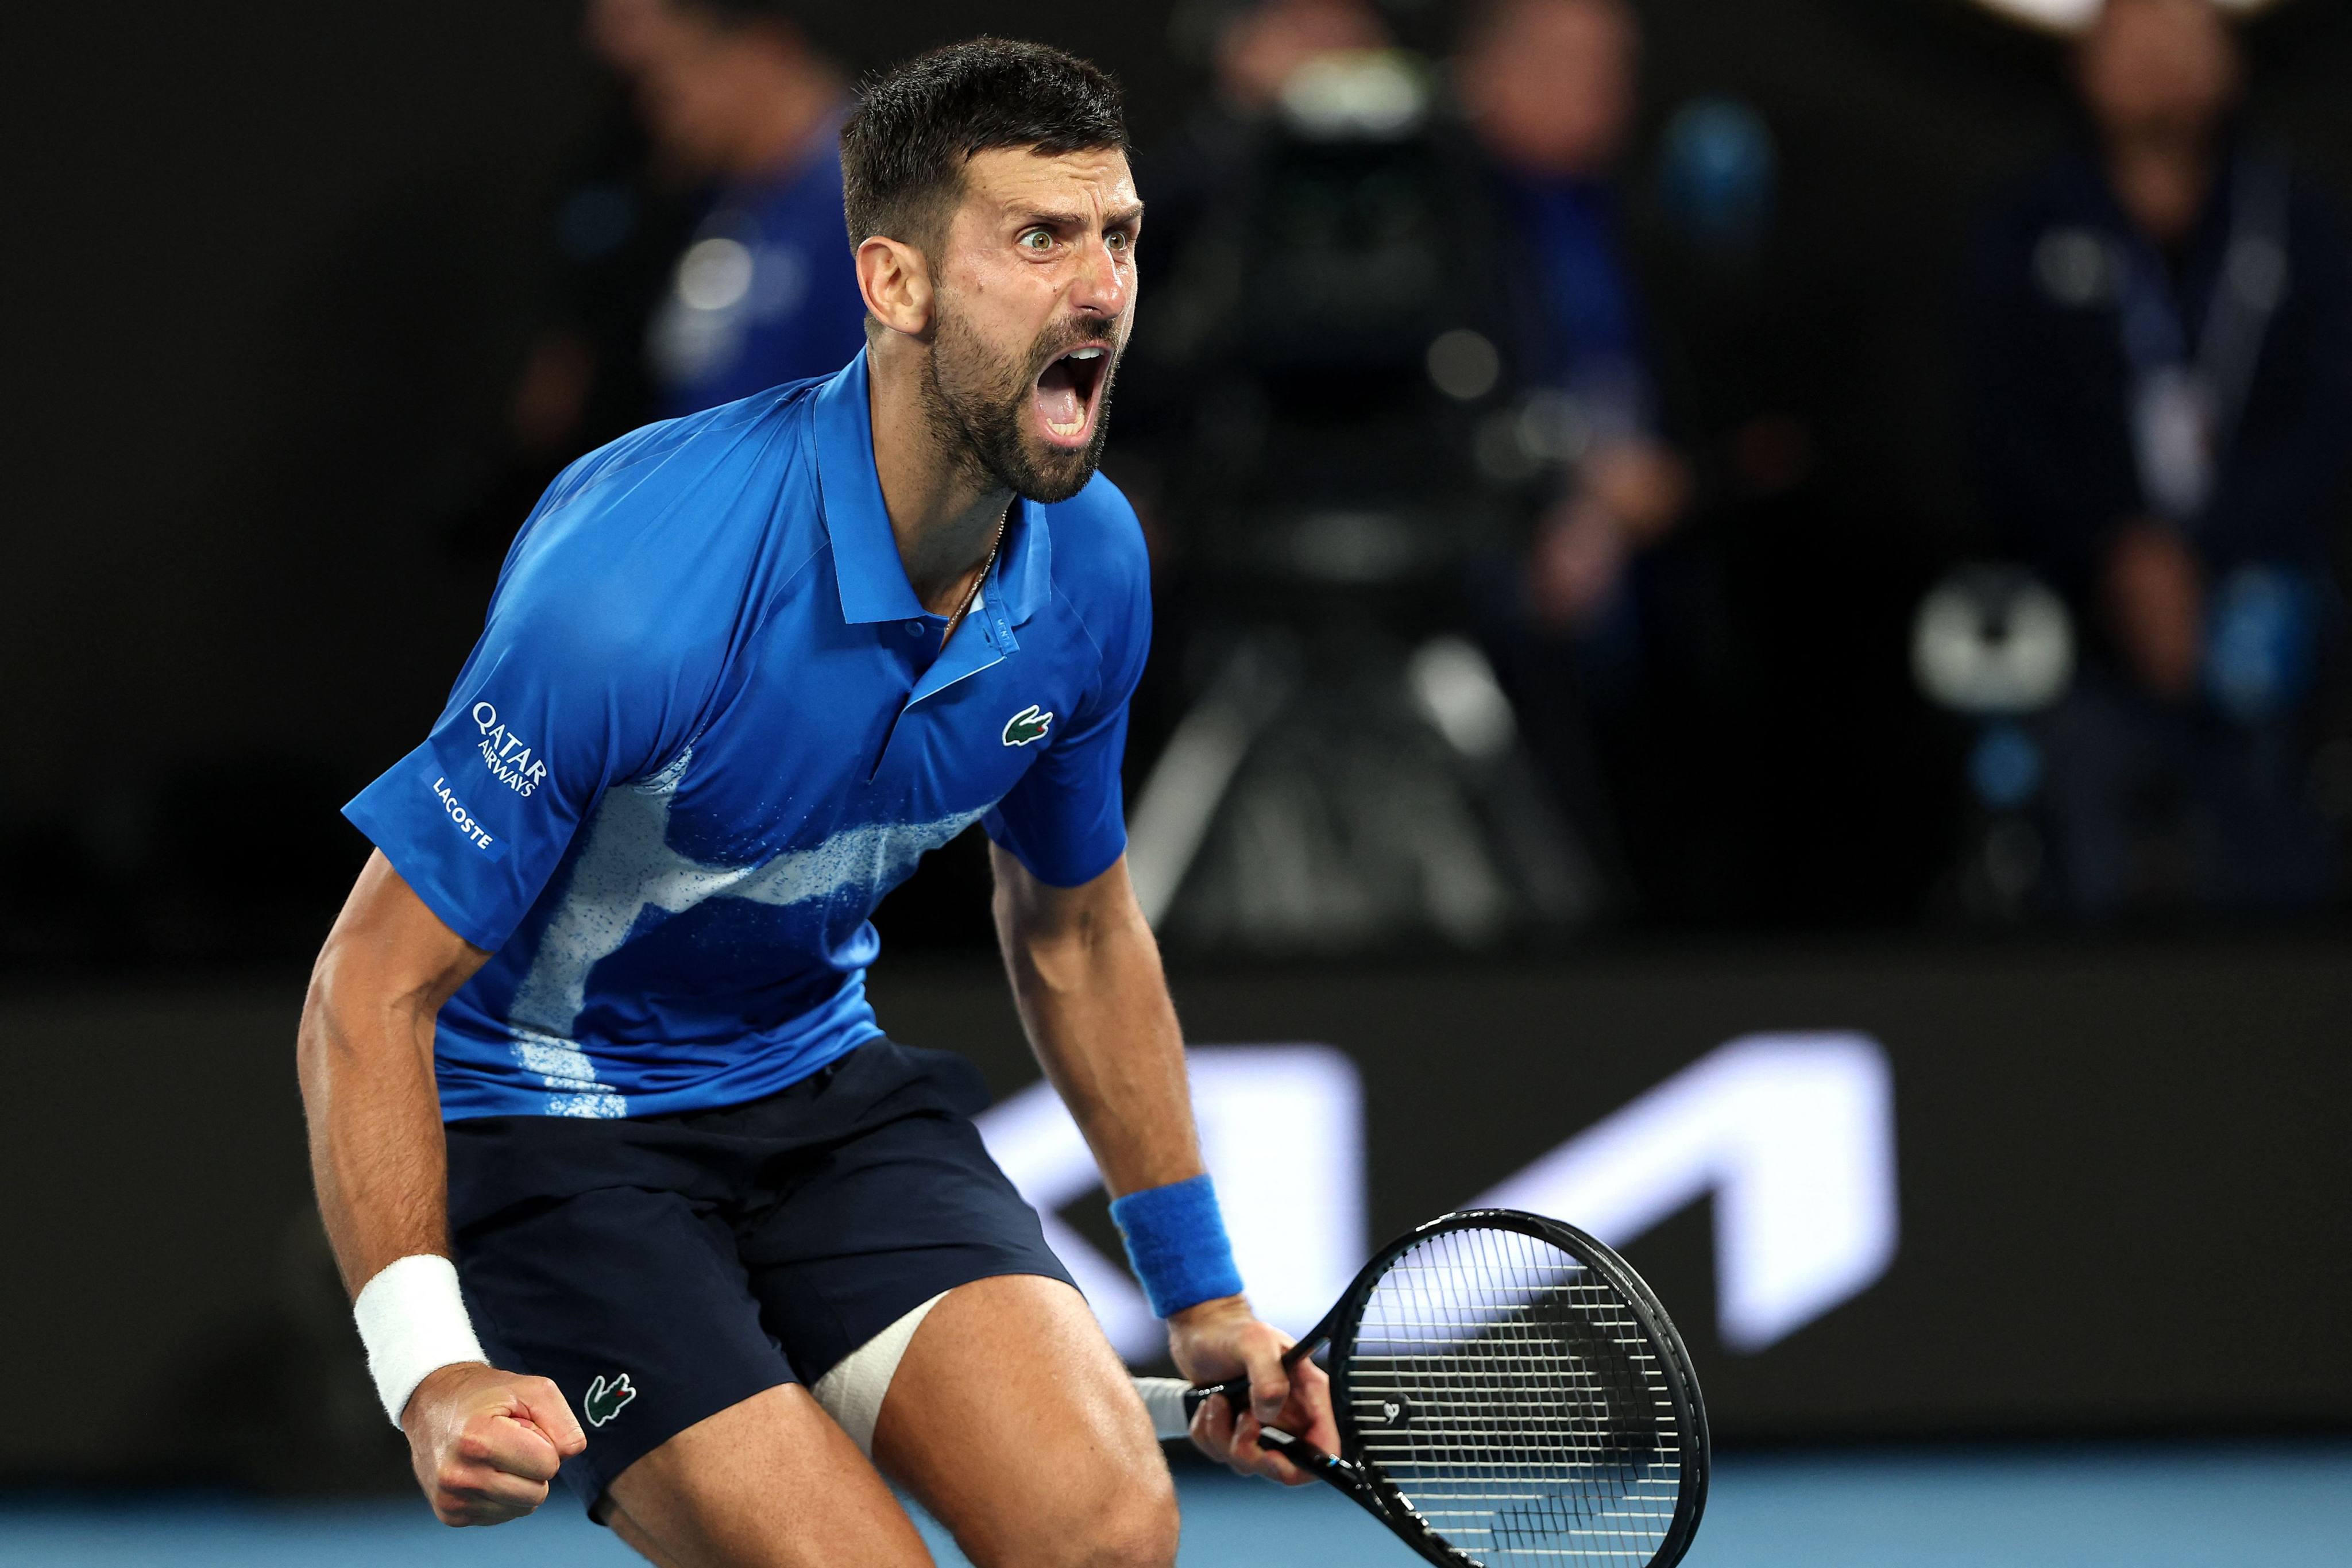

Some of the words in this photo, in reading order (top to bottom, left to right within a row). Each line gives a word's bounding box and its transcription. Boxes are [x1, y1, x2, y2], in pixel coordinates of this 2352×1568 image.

[473, 702, 547, 786] QATAR
[478, 739, 535, 797] AIRWAYS
[433, 777, 493, 849] LACOSTE
